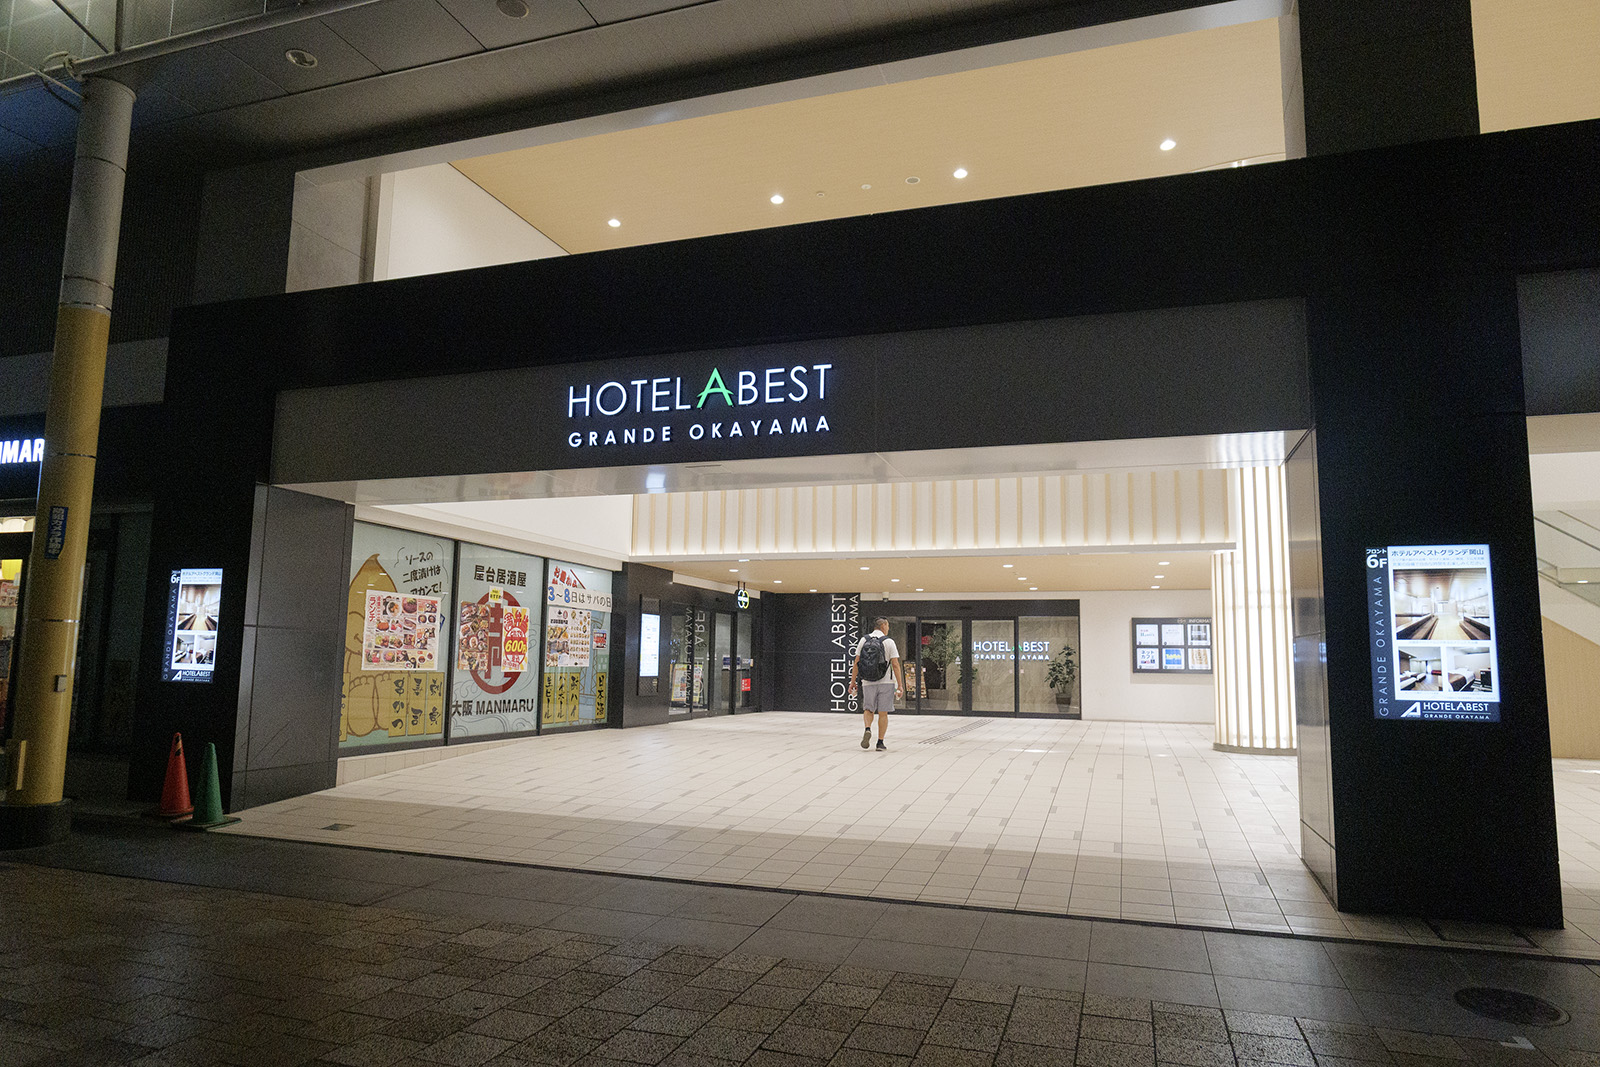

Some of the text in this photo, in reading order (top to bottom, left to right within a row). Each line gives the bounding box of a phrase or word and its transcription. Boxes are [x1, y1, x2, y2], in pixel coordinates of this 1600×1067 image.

[568, 362, 832, 418] HOTEL ABEST
[568, 415, 830, 447] GRANDE OKAYAMA
[0, 438, 45, 464] MAR
[405, 551, 433, 565] ソースの
[1366, 554, 1387, 569] 6F
[403, 565, 441, 583] 二度漬けは
[474, 565, 527, 587] 屋台居酒屋
[167, 588, 177, 635] OKAYAMA
[830, 595, 847, 711] HOTEL ABEST
[973, 641, 1011, 652] HOTEL
[1374, 576, 1389, 716] GRANDE OKAYAMA
[392, 677, 405, 730] 串かつ
[450, 698, 534, 717] 大阪 MANMARU
[1423, 702, 1489, 711] HOTEL ABEST
